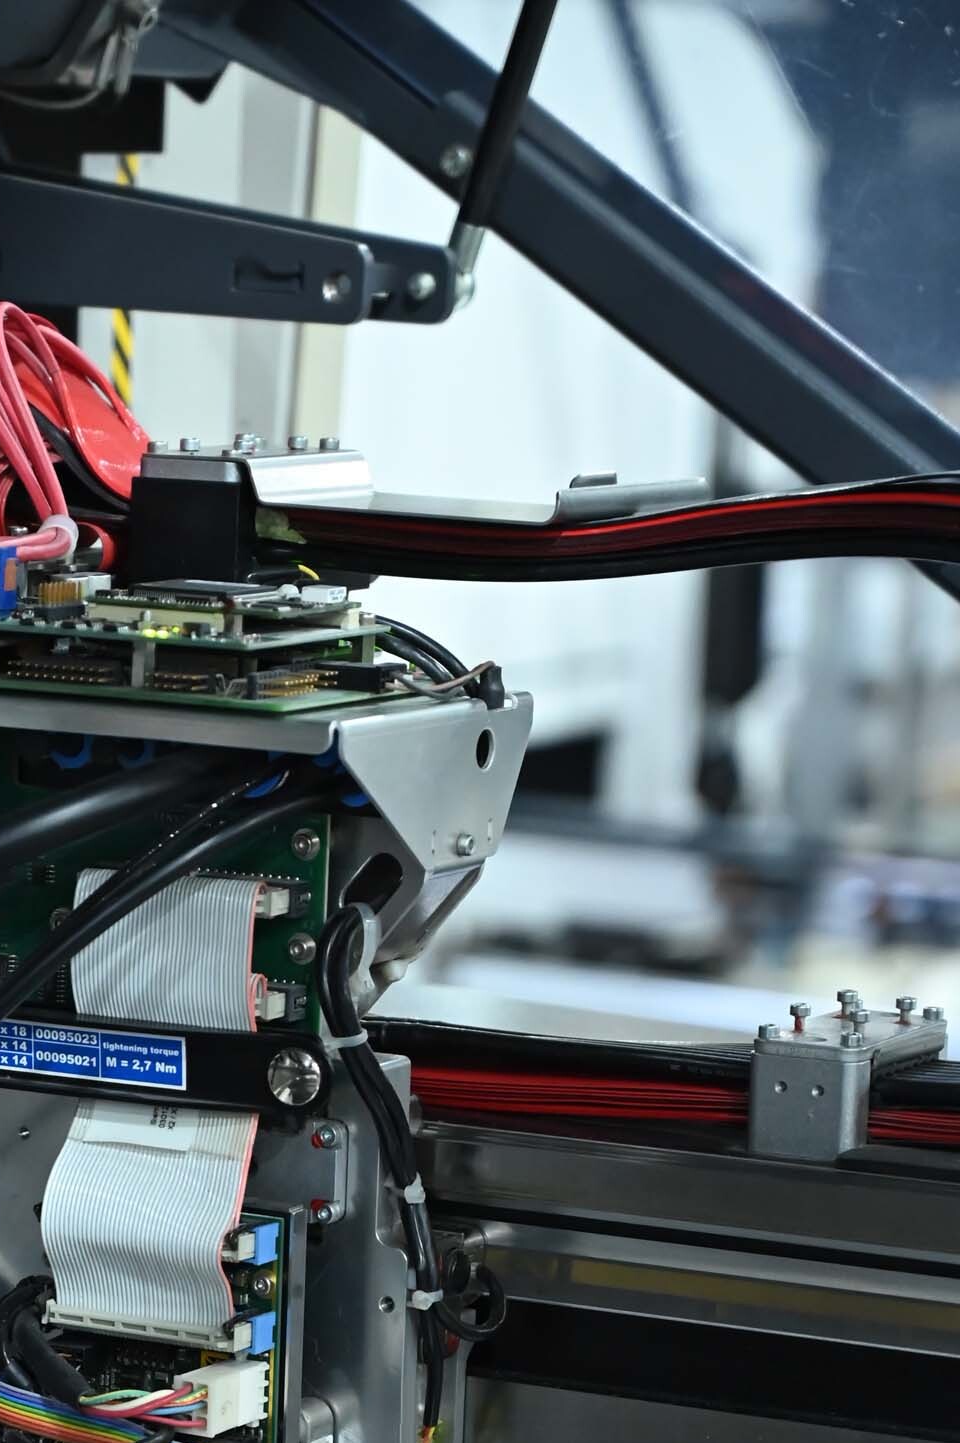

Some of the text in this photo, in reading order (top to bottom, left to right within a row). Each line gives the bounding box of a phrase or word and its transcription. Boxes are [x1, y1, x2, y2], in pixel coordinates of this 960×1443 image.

[12, 1025, 27, 1037] 18
[35, 1028, 98, 1044] 00095023
[0, 1041, 8, 1049] x
[12, 1040, 27, 1052] 14
[103, 1042, 179, 1057] tightening torque
[0, 1055, 8, 1064] x
[12, 1054, 28, 1066] 14
[36, 1051, 97, 1067] 00095021
[106, 1057, 117, 1067] M
[132, 1059, 152, 1072] 2,7
[155, 1062, 177, 1074] Nm
